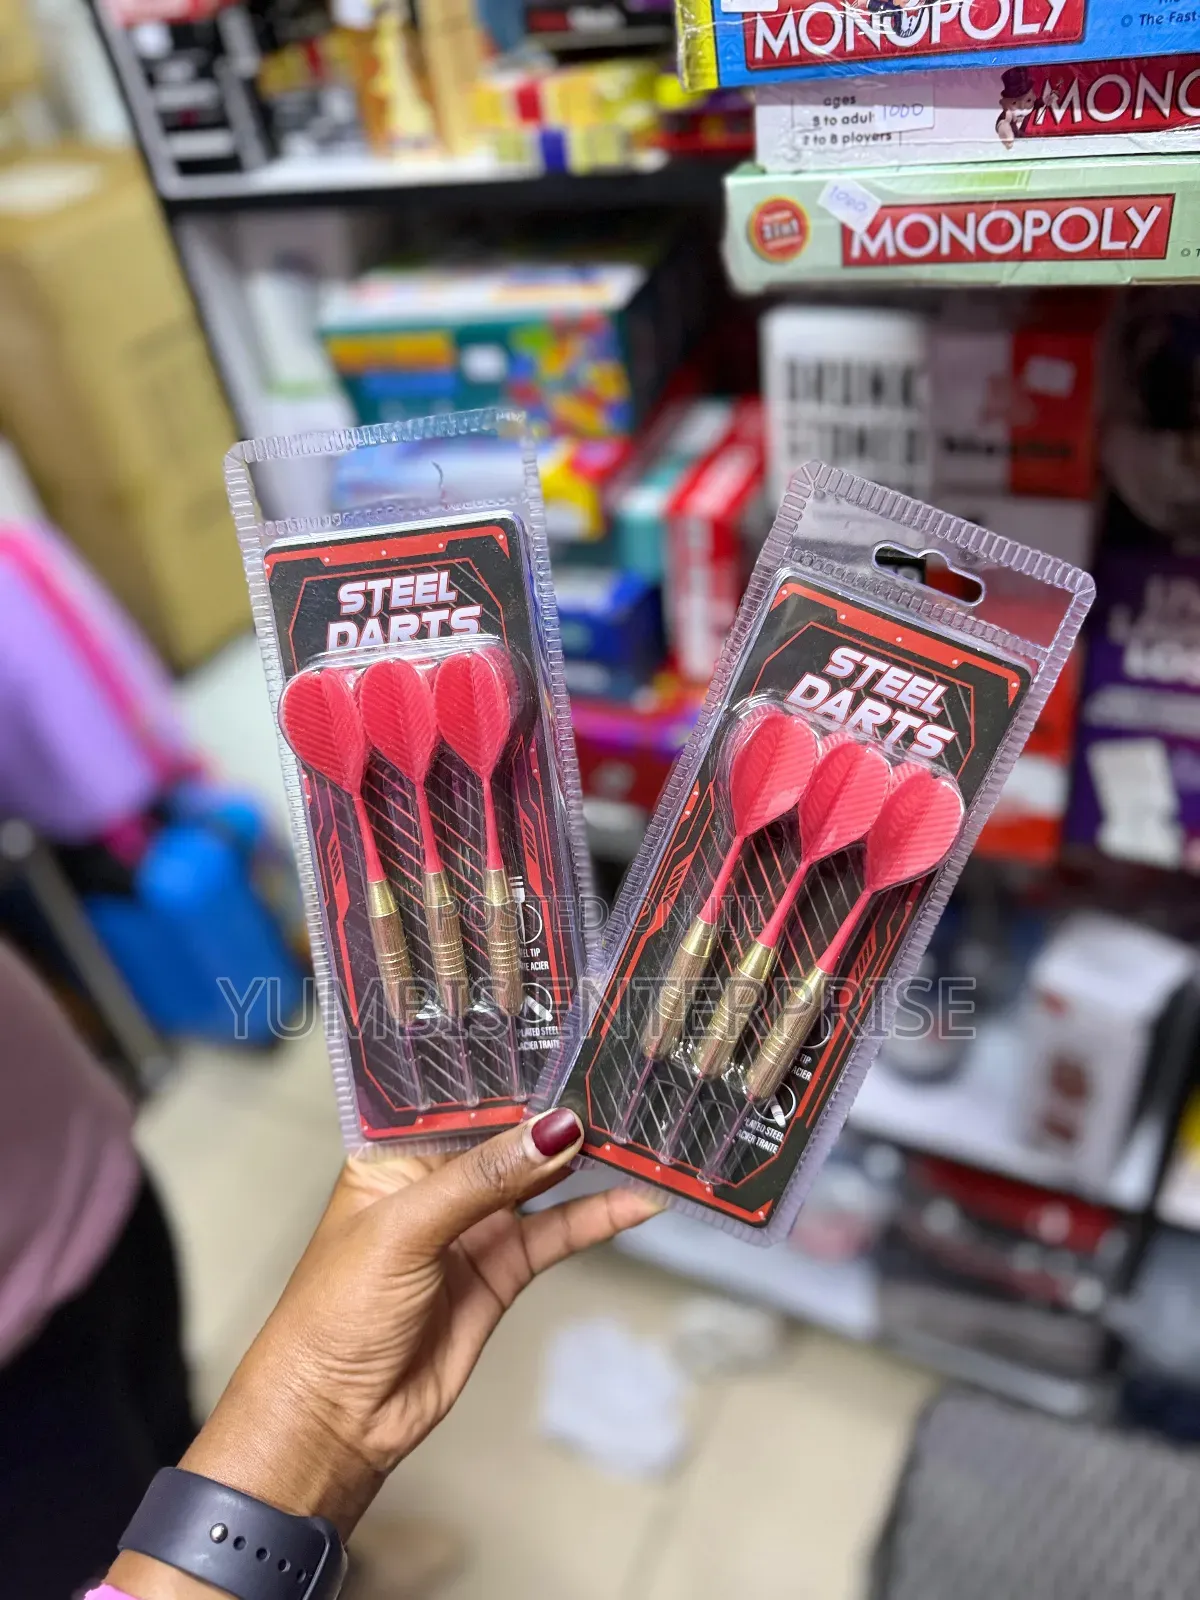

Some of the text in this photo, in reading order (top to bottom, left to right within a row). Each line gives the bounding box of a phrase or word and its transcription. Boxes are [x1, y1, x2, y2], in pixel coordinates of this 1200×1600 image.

[1139, 13, 1164, 26] The
[754, 0, 1070, 60] MONOPOLY
[823, 95, 857, 109] ages
[824, 115, 838, 126] to
[841, 112, 875, 125] adul
[813, 134, 826, 145] to
[850, 204, 1162, 259] MONOPOLY
[337, 571, 458, 616] STEEL
[325, 604, 483, 652] DARTS
[822, 645, 949, 717] STEEL
[784, 672, 958, 759] DARTS
[530, 948, 541, 958] TIP
[530, 961, 549, 971] ACIER
[791, 1065, 813, 1082] ACIER
[764, 1126, 785, 1142] STEEL
